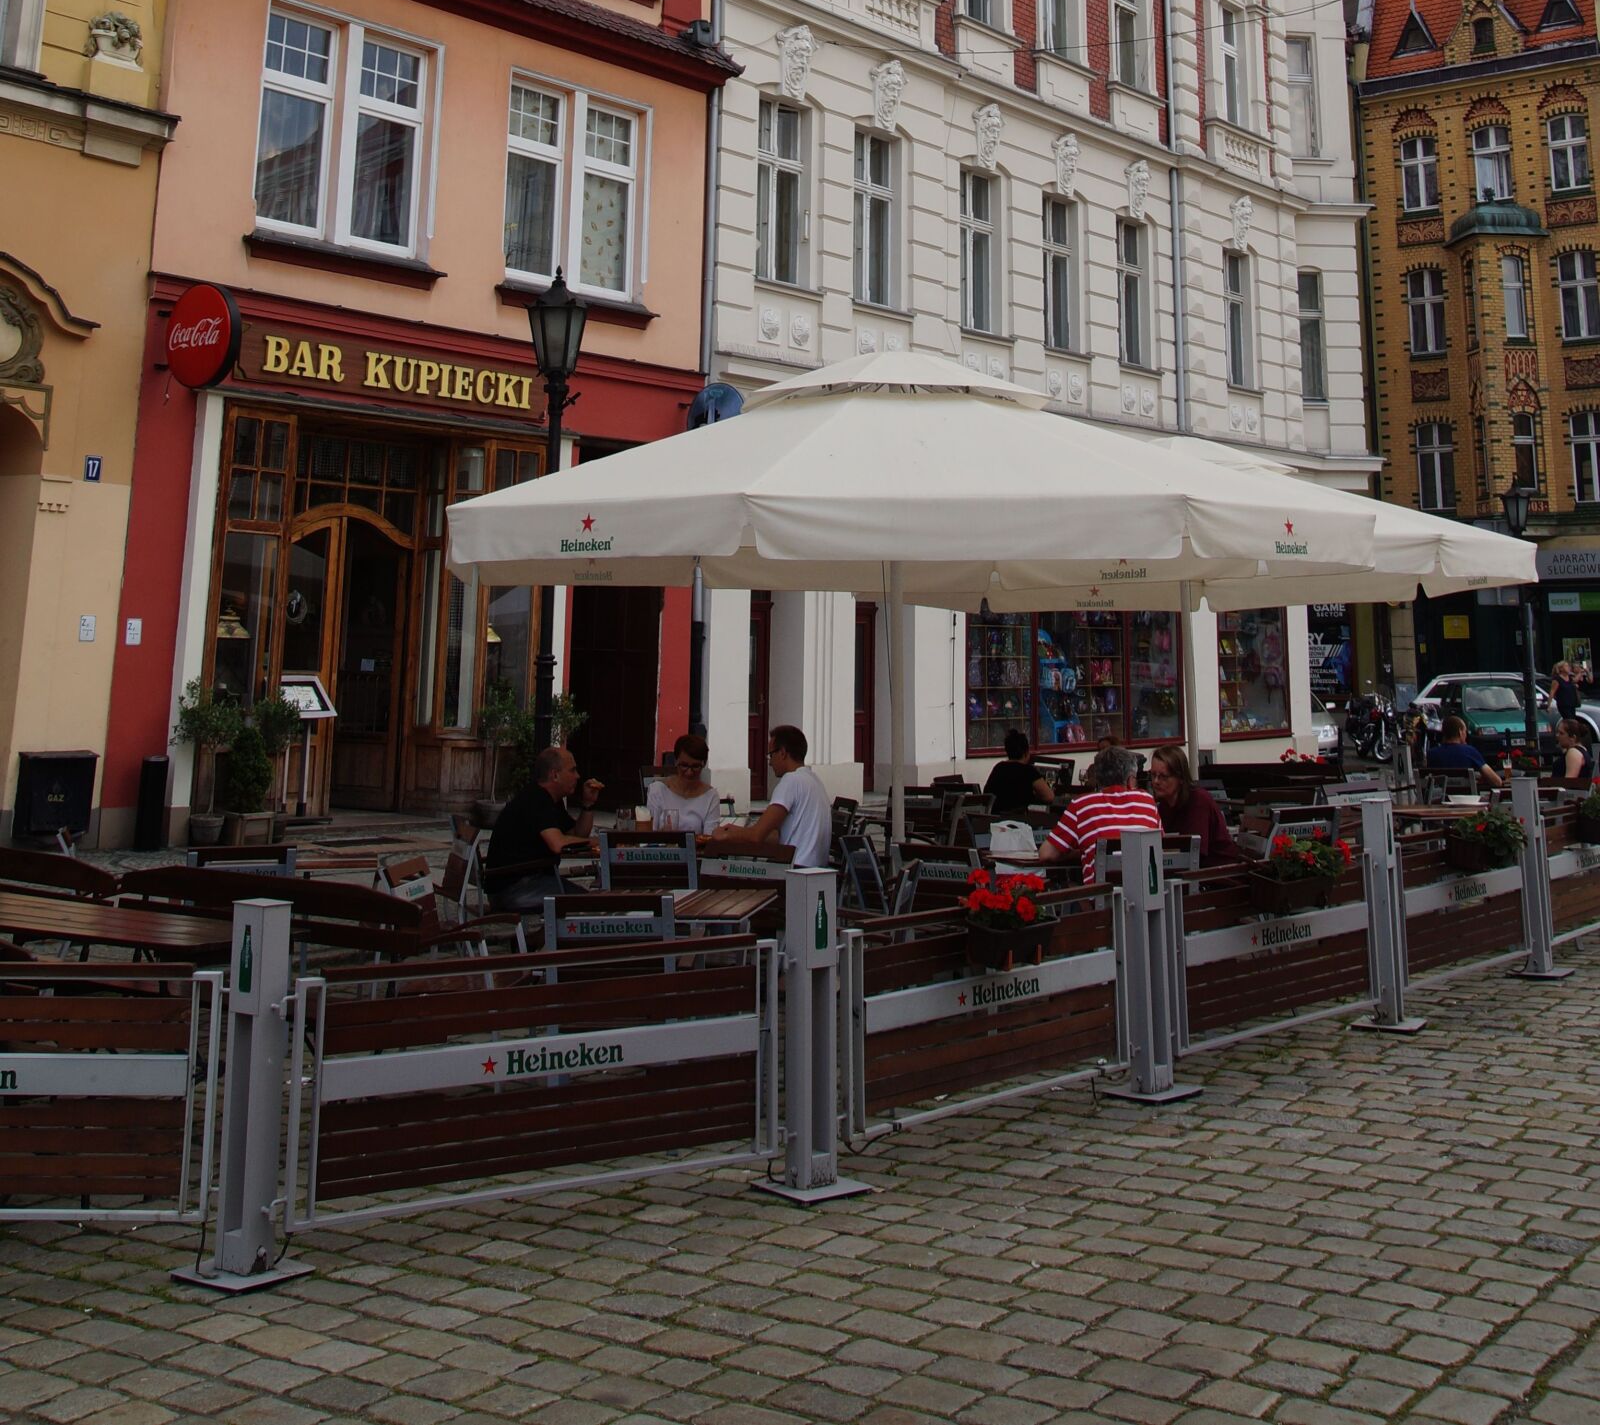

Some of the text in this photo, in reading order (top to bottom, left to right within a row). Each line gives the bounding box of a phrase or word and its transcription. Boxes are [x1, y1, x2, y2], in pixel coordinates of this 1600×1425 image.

[168, 317, 224, 351] Coca-Cola
[262, 335, 533, 410] BAR KUPIECKI
[87, 460, 100, 478] 17
[560, 538, 611, 553] Heineken
[1275, 541, 1307, 555] Heineken
[1553, 553, 1596, 564] APARATY
[1313, 603, 1346, 612] GAME
[47, 794, 65, 802] GAZ
[625, 850, 681, 862] Heineken
[728, 864, 767, 876] Heineken
[1454, 881, 1487, 901] Heineken
[579, 921, 653, 935] Heineken
[1262, 922, 1312, 946] Heineken
[972, 977, 1039, 1006] Heineken
[506, 1042, 624, 1075] Heineken
